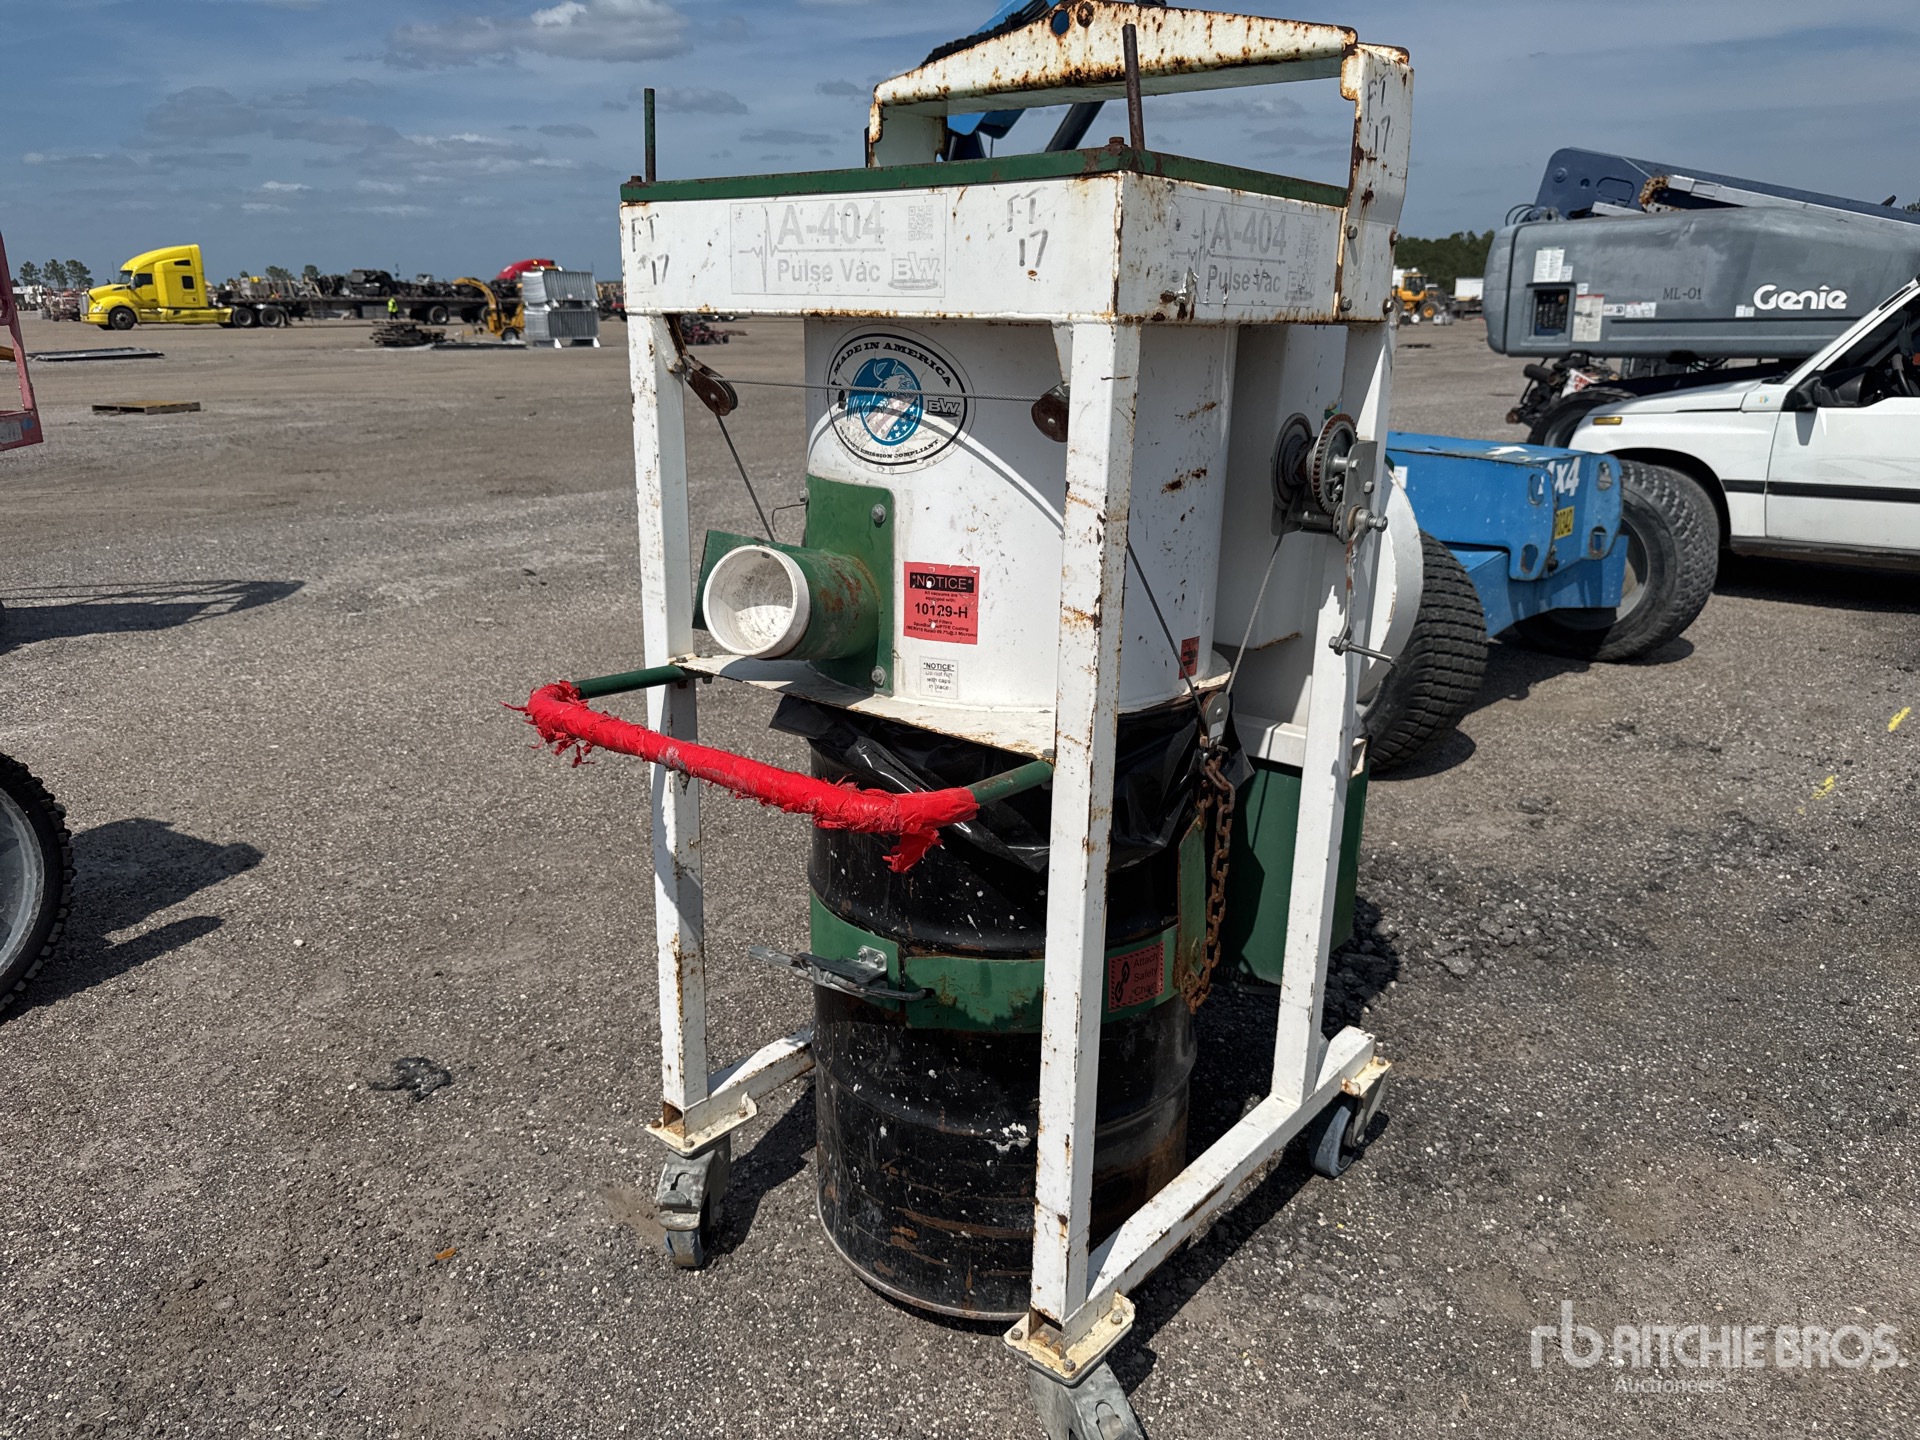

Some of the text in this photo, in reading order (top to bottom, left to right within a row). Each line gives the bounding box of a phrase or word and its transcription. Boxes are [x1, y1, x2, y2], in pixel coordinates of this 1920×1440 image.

[776, 200, 886, 246] A-404
[1210, 205, 1287, 256] A-404
[1018, 229, 1048, 268] 17
[777, 258, 881, 283] Pulse Vac
[1207, 264, 1281, 293] Pulse Vac
[1753, 283, 1847, 310] Genie
[833, 341, 952, 387] MADE IN AMERICA
[894, 438, 939, 459] COMPLIANT
[915, 602, 968, 618] 10129-H
[1133, 952, 1158, 968] Attach
[1133, 968, 1158, 982] Safety
